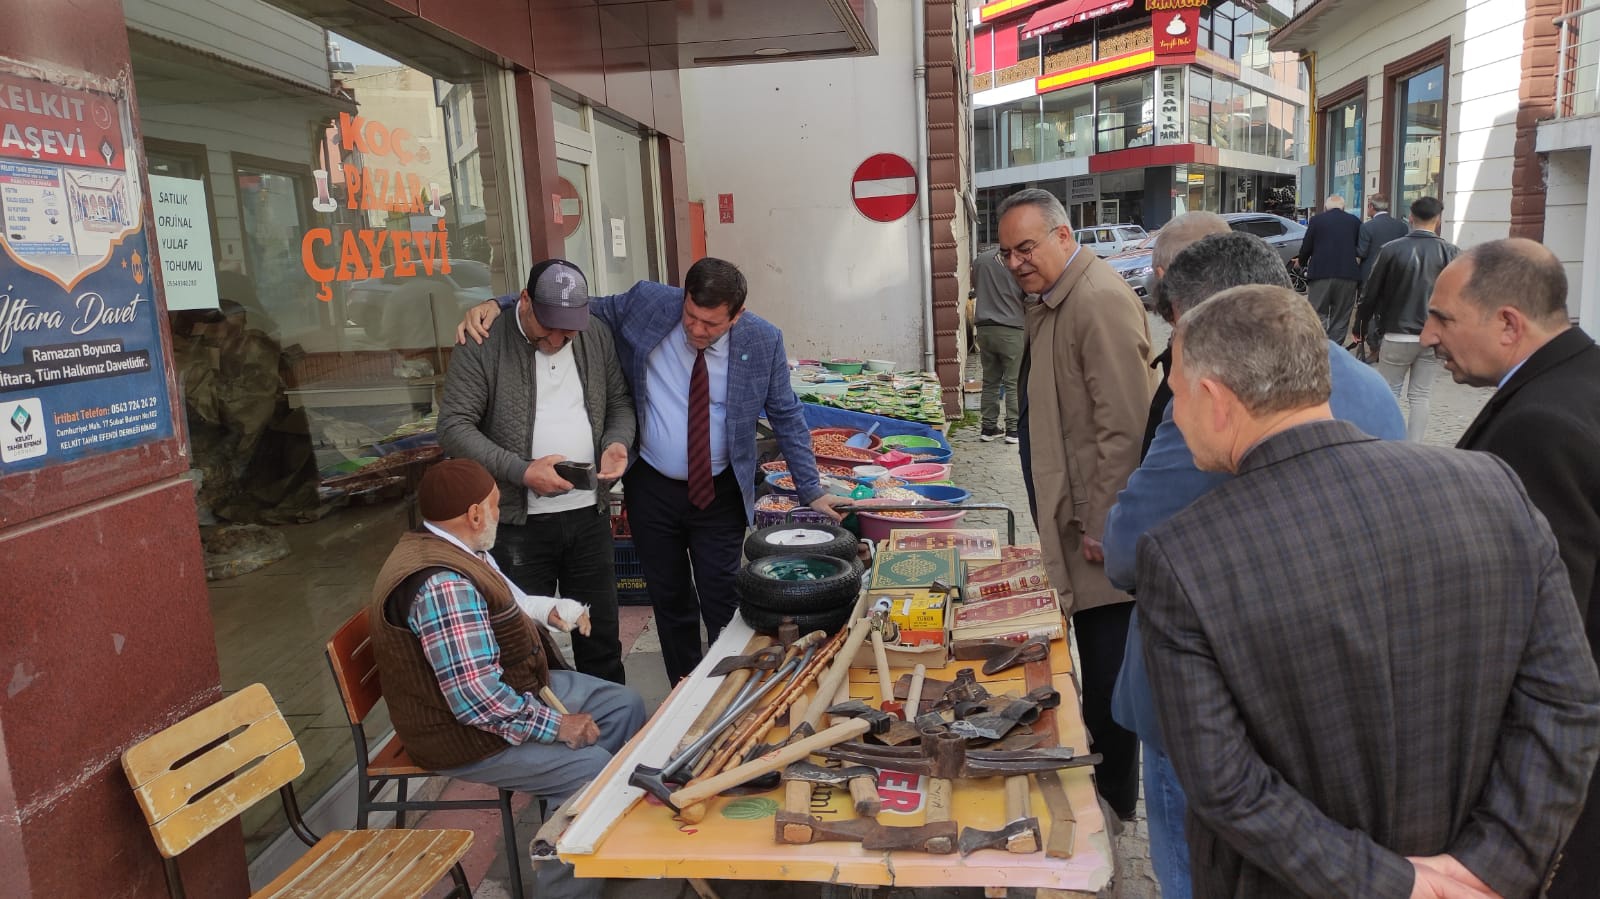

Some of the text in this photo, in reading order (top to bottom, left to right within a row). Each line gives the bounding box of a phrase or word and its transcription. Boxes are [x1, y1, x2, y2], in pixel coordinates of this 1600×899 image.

[1, 123, 87, 159] AŞEVİ
[339, 111, 414, 166] KOÇ
[1160, 130, 1180, 140] PARK
[158, 191, 188, 206] SATILIK
[343, 163, 425, 214] PAZAR
[158, 214, 193, 229] ORJİNAL
[161, 238, 189, 250] YULAF
[164, 260, 203, 272] TOHUMU
[301, 218, 452, 303] ÇAYEVİ
[70, 291, 150, 335] Davet
[32, 343, 122, 363] Ramazan Boyunca
[36, 367, 61, 382] Tüm
[62, 362, 105, 378] Halkımız
[106, 356, 149, 372] Davetlidir.
[54, 411, 79, 425] İrtibat
[80, 407, 110, 420] Telefon:
[111, 402, 128, 414] 0543
[60, 438, 82, 450] KELKİT
